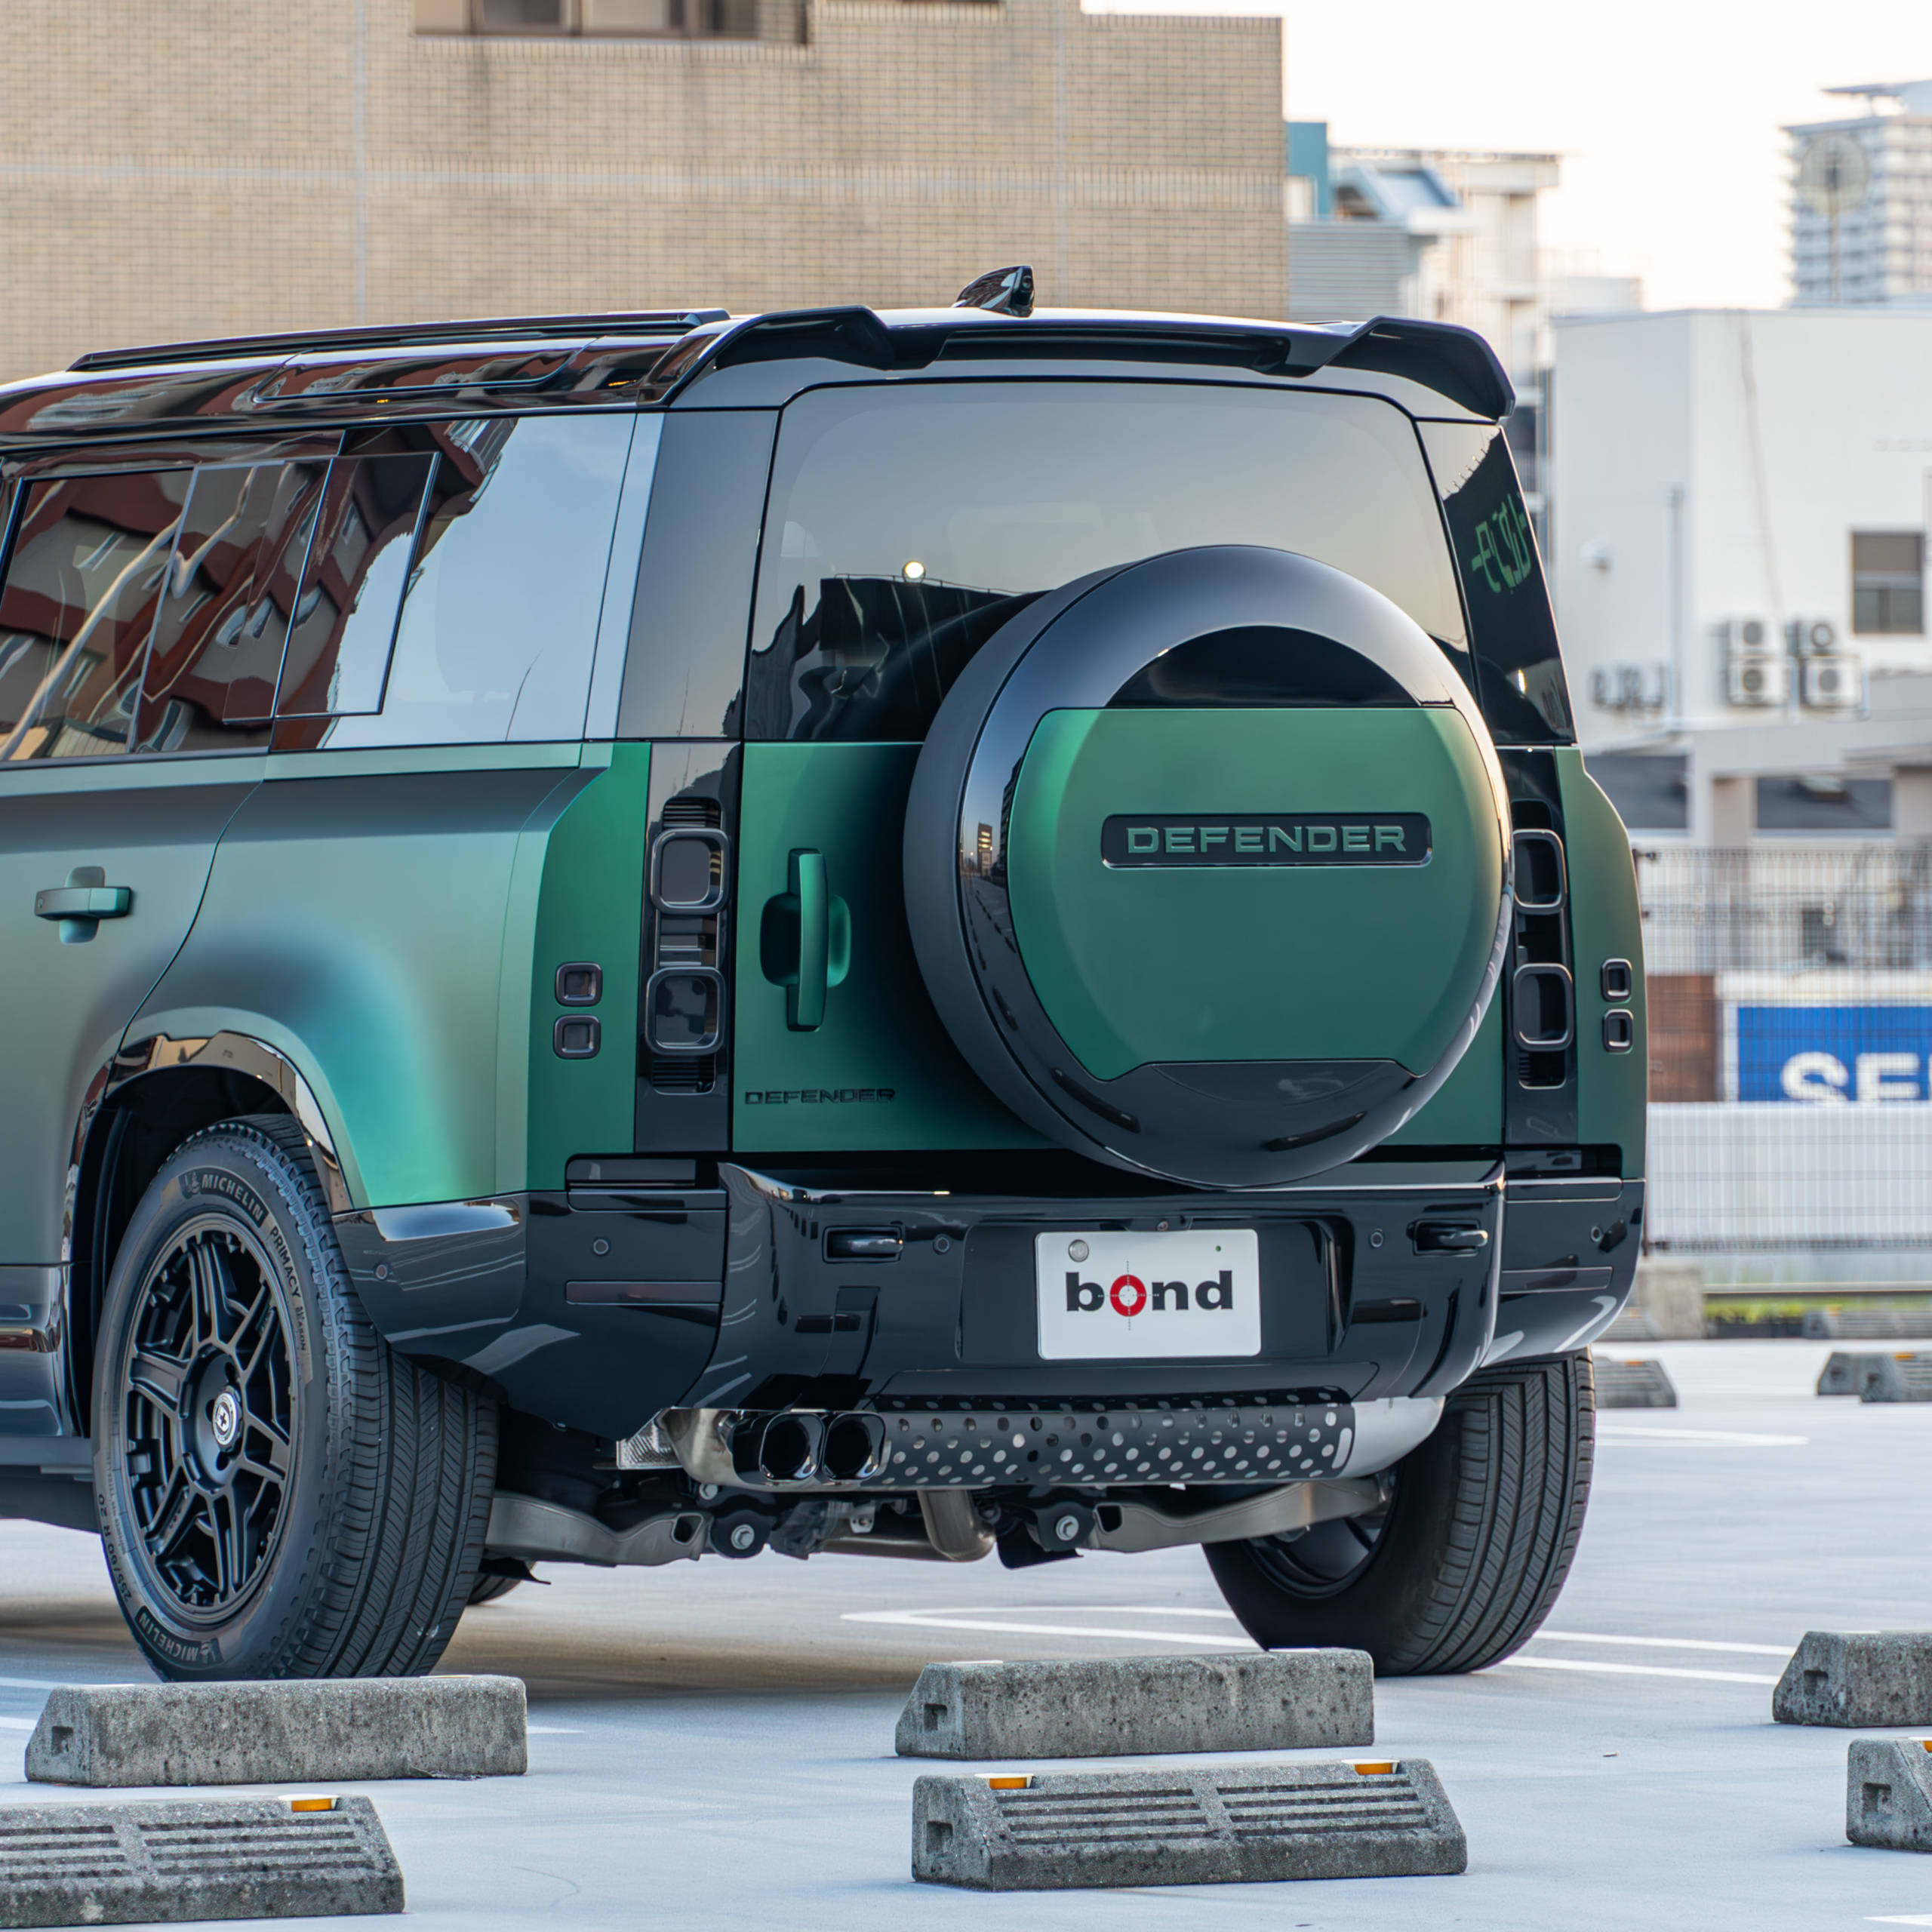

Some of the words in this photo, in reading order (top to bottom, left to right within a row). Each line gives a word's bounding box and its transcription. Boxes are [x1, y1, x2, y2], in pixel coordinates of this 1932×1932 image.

[1126, 825, 1407, 854] DEFENDER
[744, 1088, 897, 1105] DEFENDER
[201, 1174, 264, 1222] MICHELIN
[269, 1226, 301, 1299] PRIMACY
[1065, 1269, 1234, 1318] bond
[98, 1493, 108, 1518] 20
[103, 1524, 112, 1537] R
[107, 1543, 132, 1602] 255/60
[138, 1612, 198, 1661] MICHELIN
